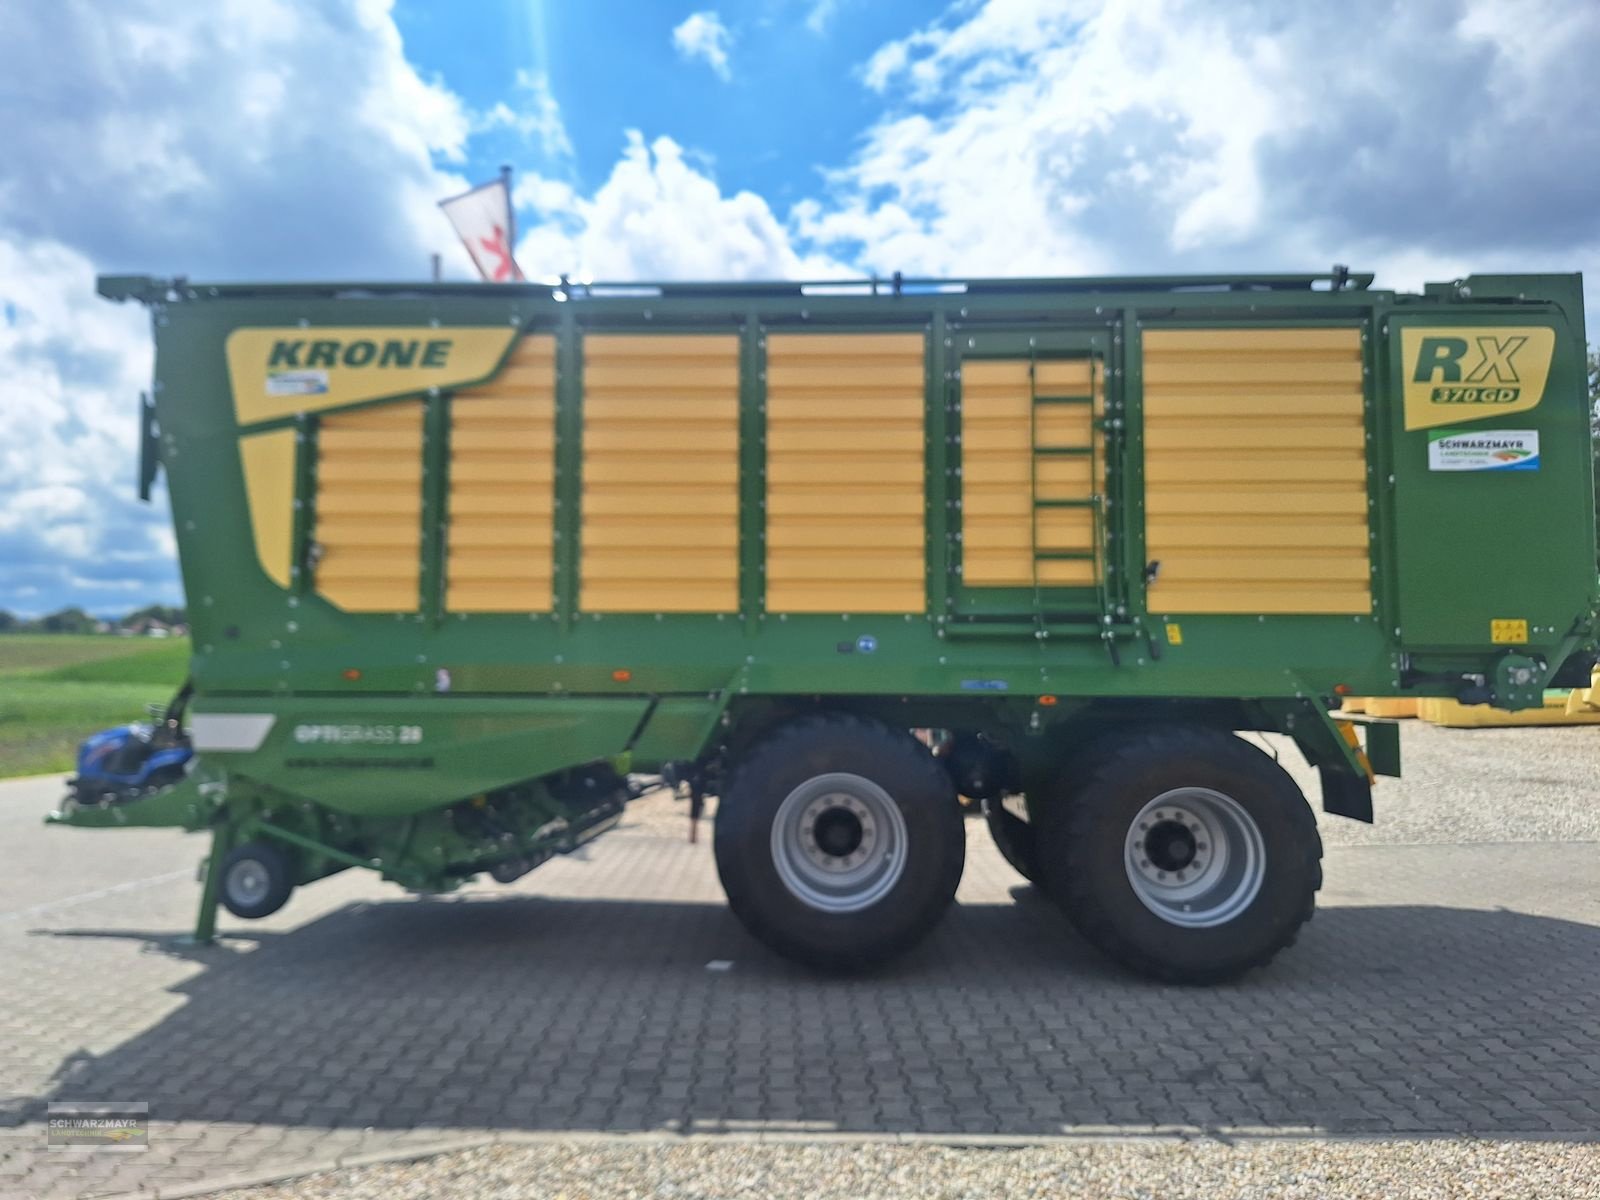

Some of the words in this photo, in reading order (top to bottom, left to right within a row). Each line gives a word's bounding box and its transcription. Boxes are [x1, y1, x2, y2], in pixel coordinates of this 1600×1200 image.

[267, 339, 453, 368] KRONE
[1413, 336, 1529, 383] RX
[1436, 388, 1477, 402] 370
[1481, 388, 1515, 402] GD
[1438, 440, 1524, 449] SCHWARZMAYR
